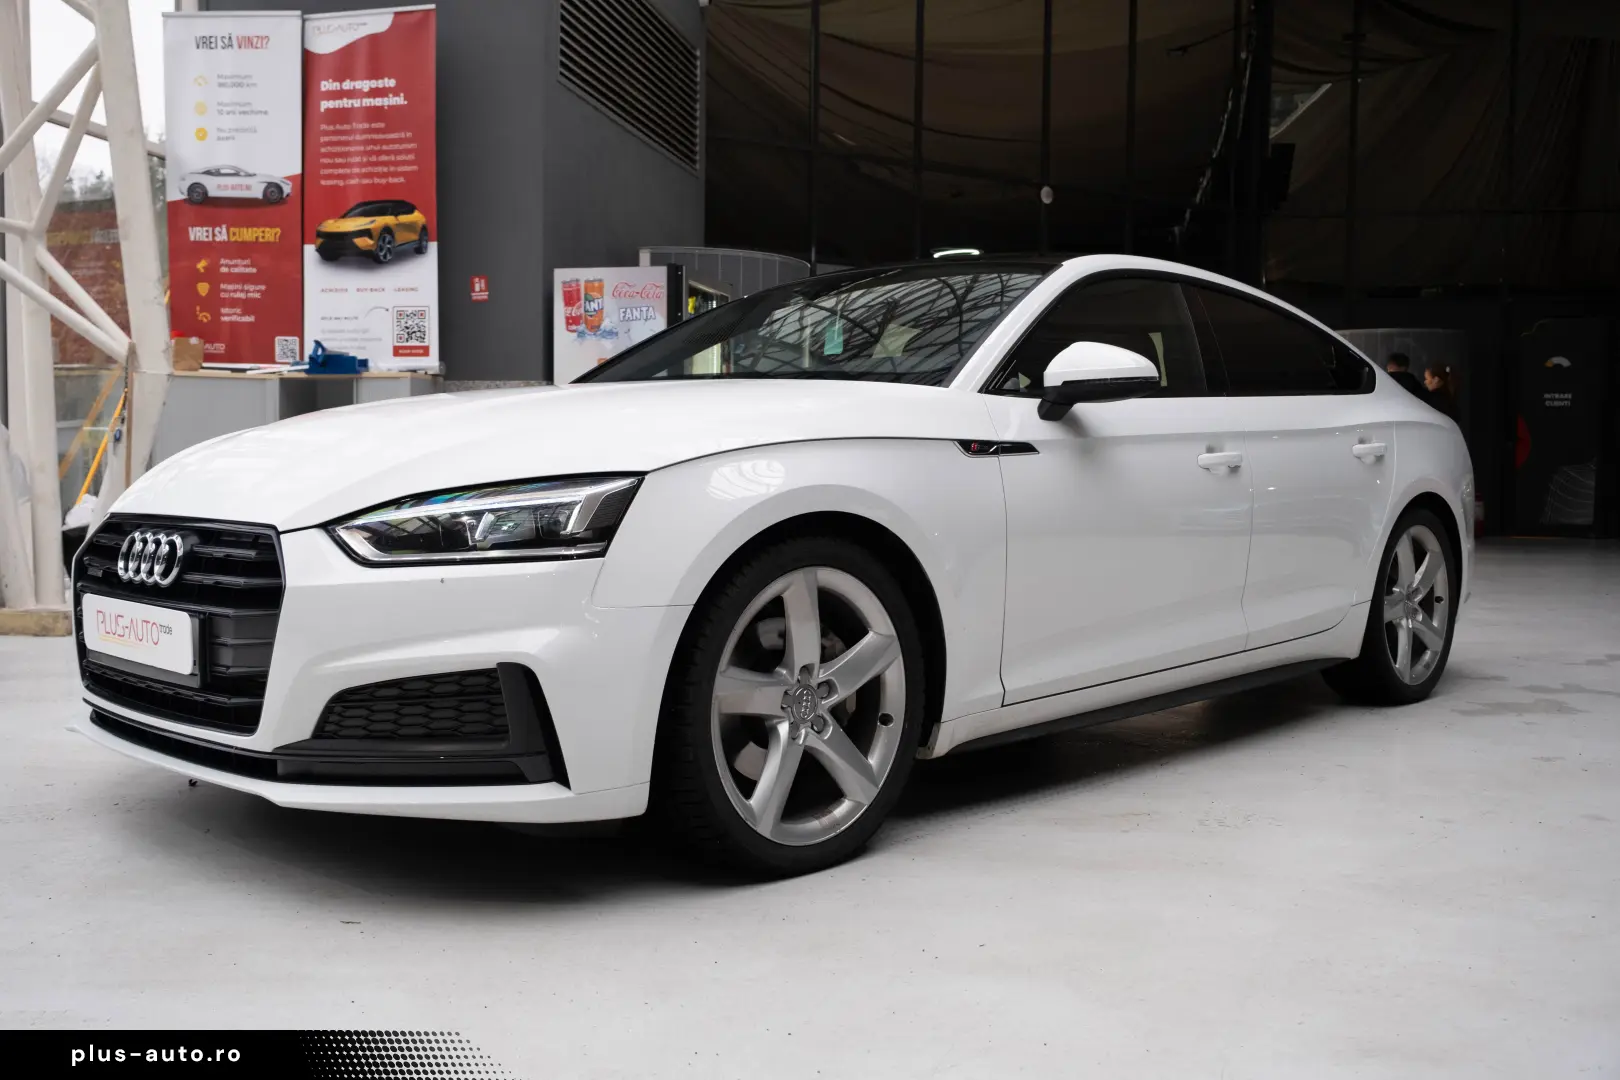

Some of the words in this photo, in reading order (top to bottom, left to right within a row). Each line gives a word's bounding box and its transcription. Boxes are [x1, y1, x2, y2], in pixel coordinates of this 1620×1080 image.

[194, 35, 218, 50] VREI
[220, 32, 234, 50] SĂ
[236, 35, 270, 50] VINZI?
[320, 78, 340, 91] Din
[342, 77, 396, 92] dragoste
[320, 97, 360, 113] pentru
[362, 92, 408, 110] mașini.
[188, 226, 213, 241] VREI
[214, 224, 228, 241] SĂ
[229, 227, 281, 242] CUMPERI?
[612, 281, 665, 299] Coca-Cola
[619, 305, 657, 323] FANTA
[96, 609, 160, 646] PLUS-AUTO
